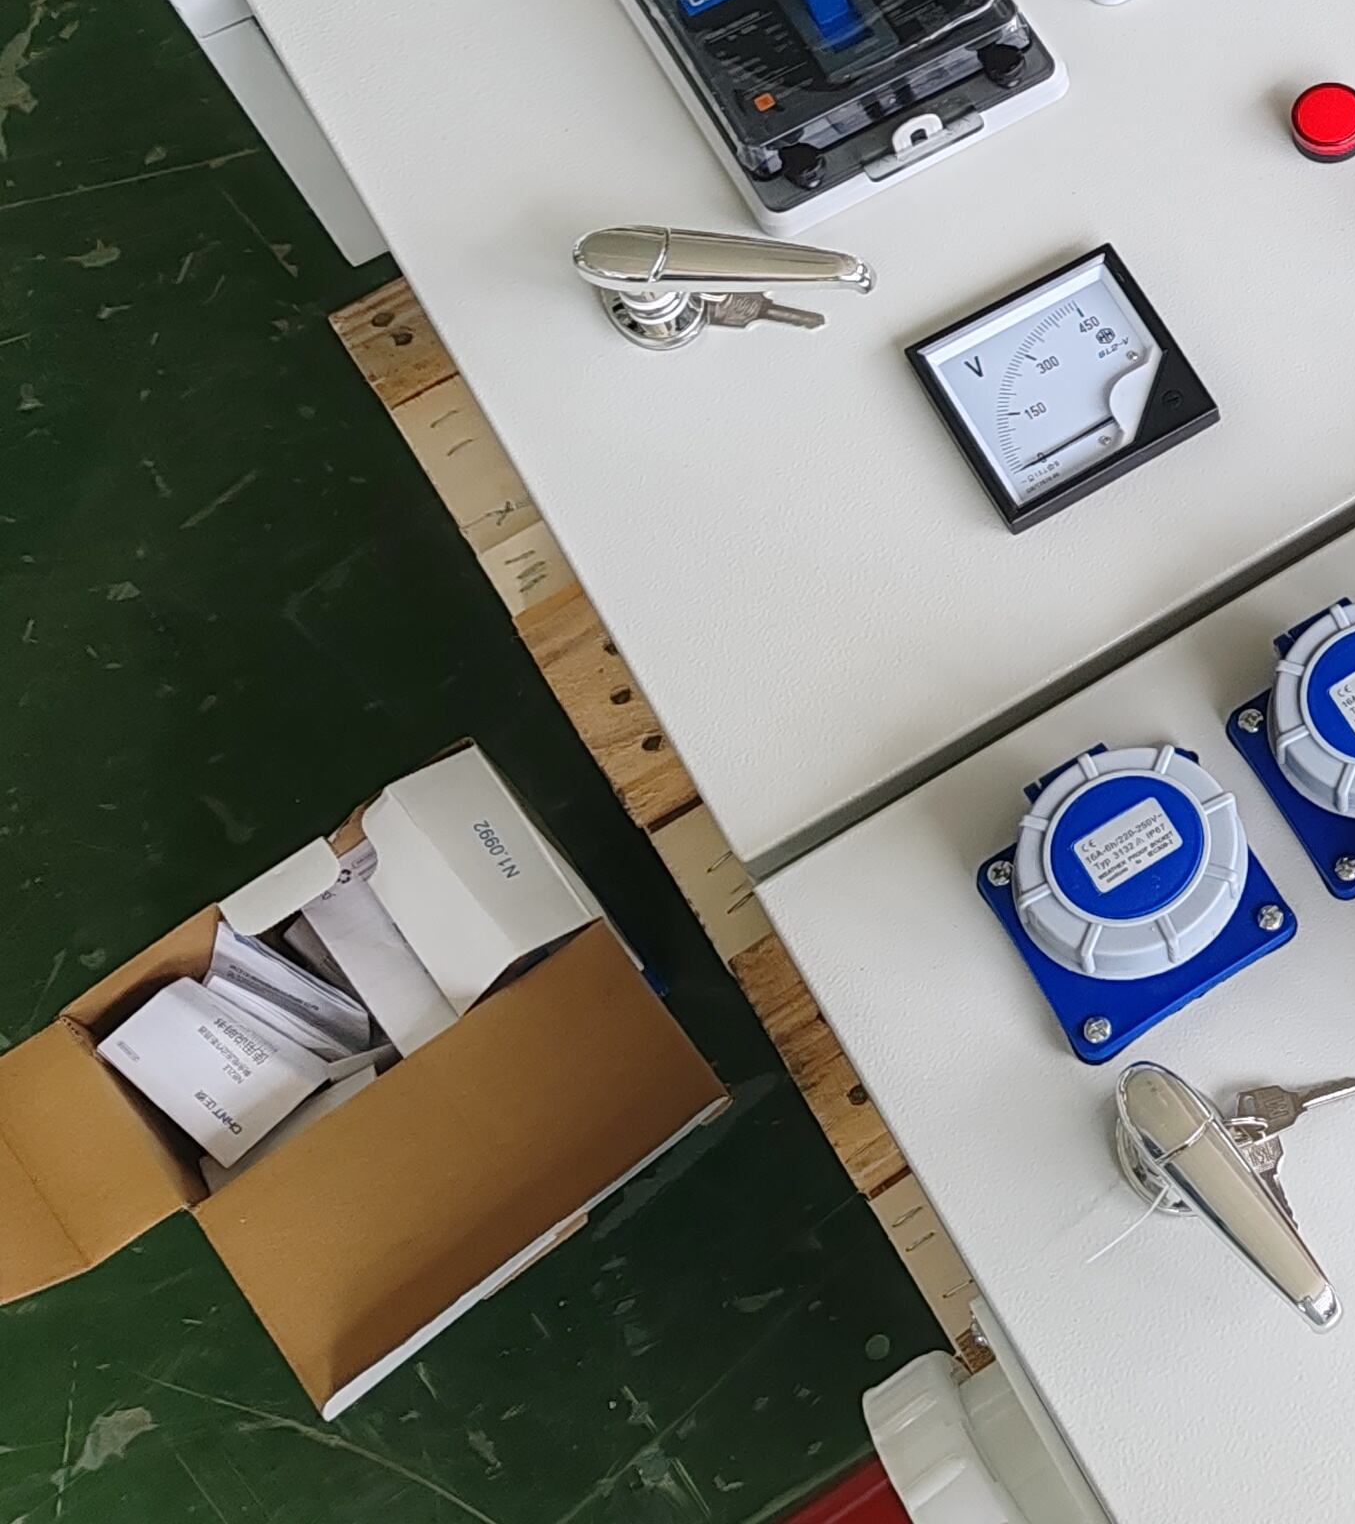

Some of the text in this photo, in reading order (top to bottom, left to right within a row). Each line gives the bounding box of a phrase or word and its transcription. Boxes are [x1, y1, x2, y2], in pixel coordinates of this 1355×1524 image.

[1078, 315, 1100, 334] 450
[964, 355, 984, 378] V
[1035, 355, 1061, 375] 300
[1024, 401, 1047, 420] 150
[472, 819, 520, 879] N1.0992
[1094, 858, 1111, 870] Typ
[1112, 842, 1134, 860] 3132
[214, 1018, 268, 1064] 使用说明书
